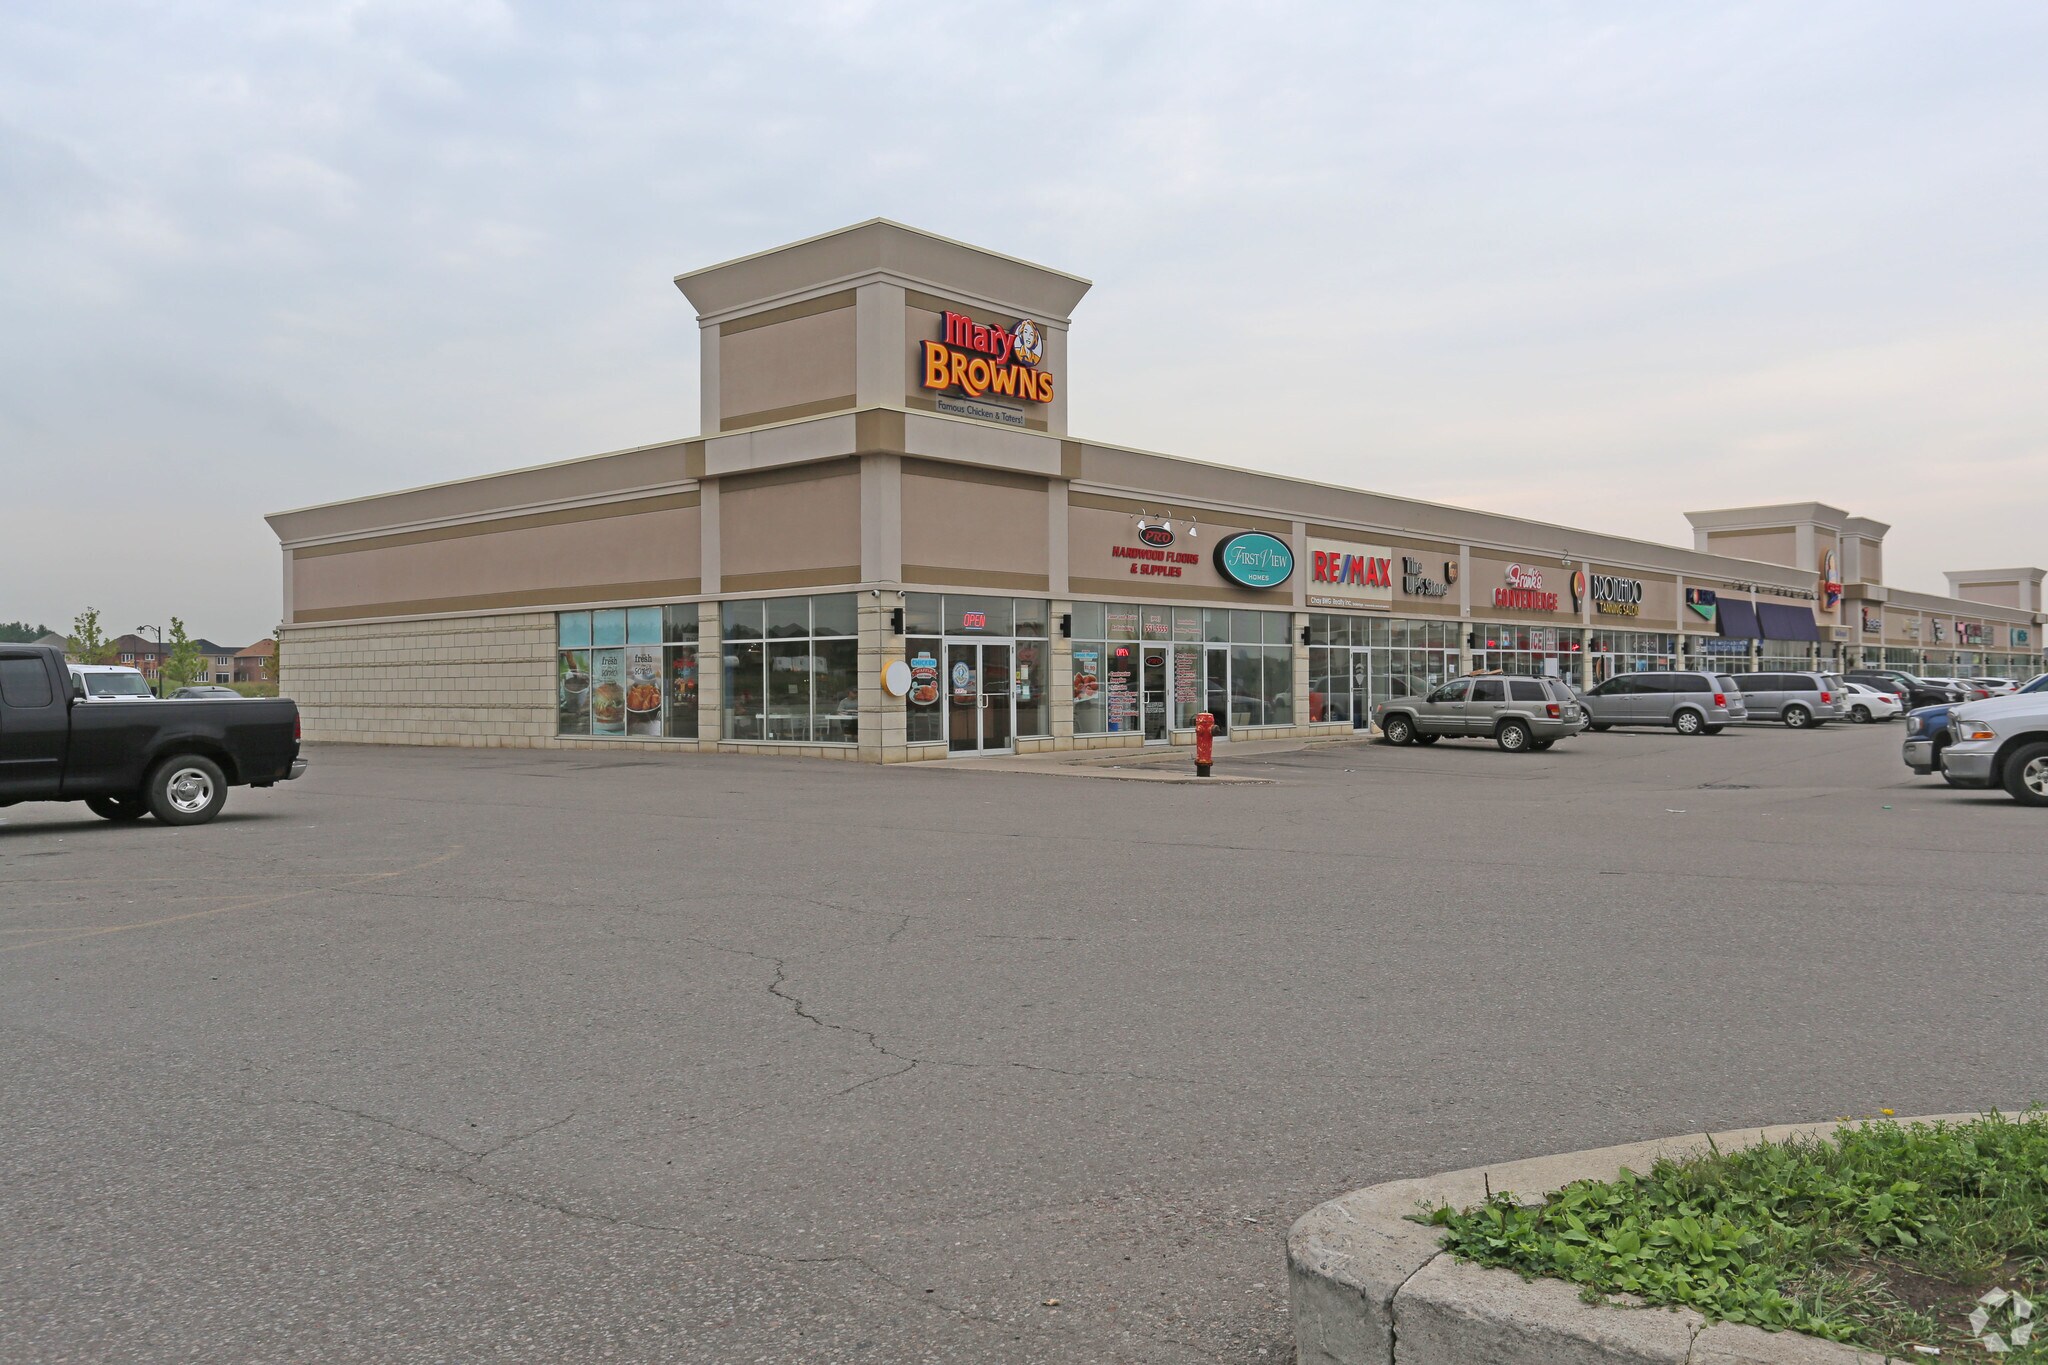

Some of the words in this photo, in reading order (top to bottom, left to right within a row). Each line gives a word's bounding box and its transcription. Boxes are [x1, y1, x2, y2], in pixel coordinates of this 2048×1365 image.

[920, 340, 1053, 403] BROWNS
[938, 400, 964, 413] Famous
[966, 405, 993, 418] Chicken
[995, 412, 1000, 420] &
[1002, 411, 1023, 424] Taters!
[1143, 530, 1171, 543] PRO
[1112, 546, 1164, 562] HARDWOOD
[1166, 551, 1199, 565] FLOORS
[1130, 563, 1138, 574] &
[1140, 564, 1182, 577] SUPPLIES
[1312, 550, 1391, 587] RE/MAX
[1402, 557, 1422, 575] The
[1505, 563, 1543, 589] Frank's
[1403, 576, 1425, 594] UPS
[1424, 578, 1448, 596] Store
[1591, 575, 1642, 604] BRONZEADO
[1492, 587, 1558, 610] CONVENIENCE
[1599, 603, 1622, 615] TANNING
[1622, 605, 1639, 616] SALON
[963, 614, 985, 627] OPEN
[1531, 632, 1542, 650] ICE
[602, 656, 618, 665] fresh
[634, 654, 652, 663] fresh
[1116, 648, 1129, 657] OPEN
